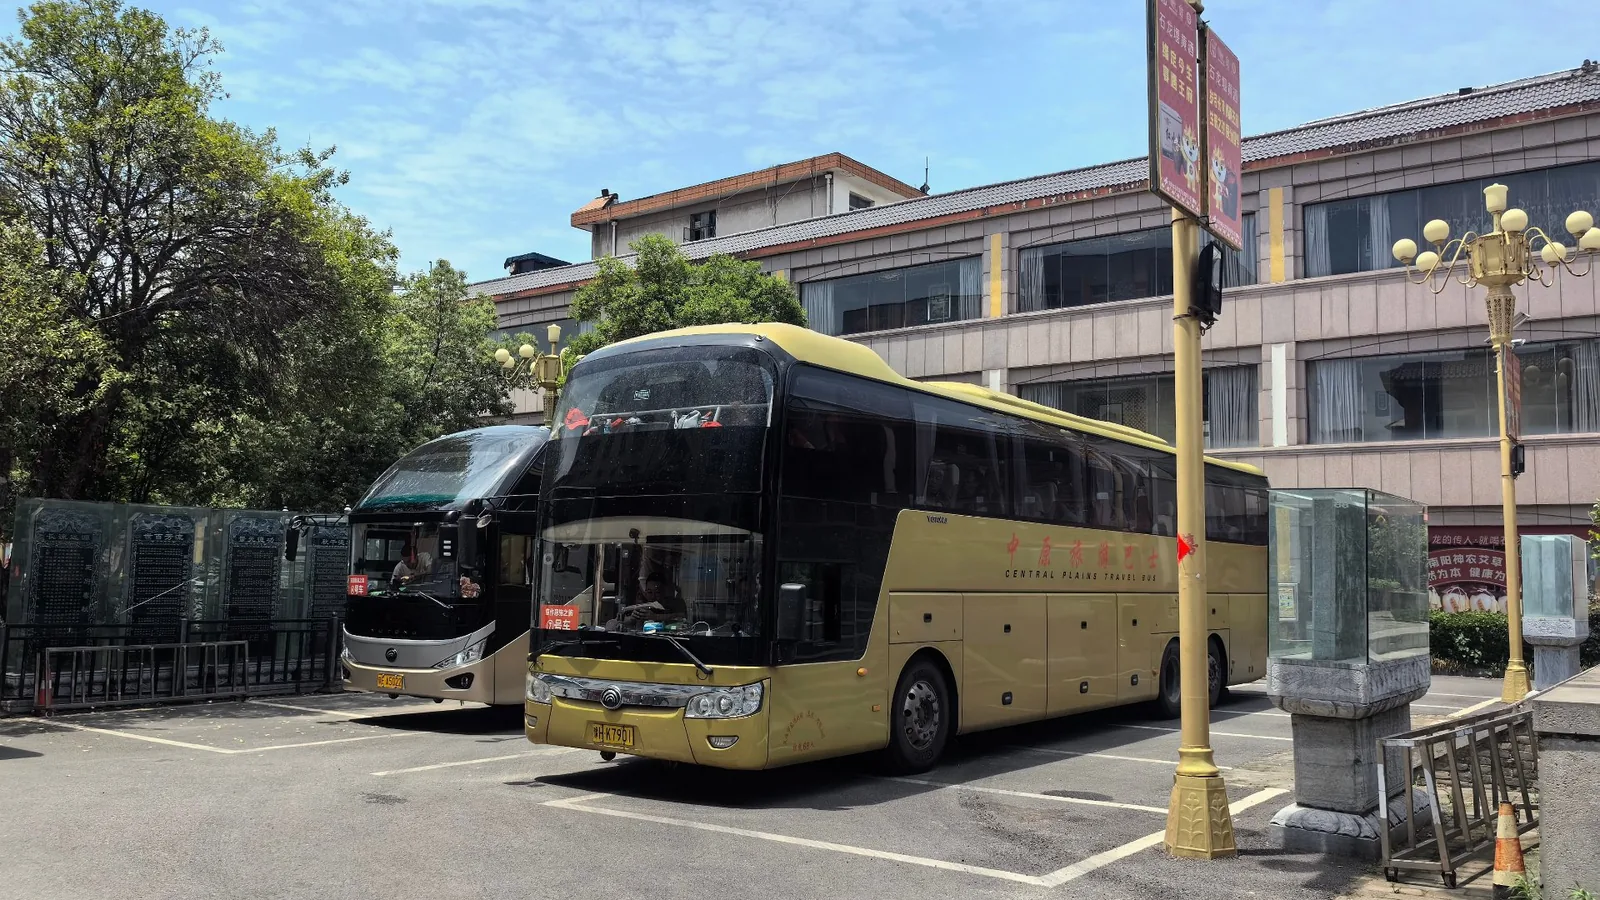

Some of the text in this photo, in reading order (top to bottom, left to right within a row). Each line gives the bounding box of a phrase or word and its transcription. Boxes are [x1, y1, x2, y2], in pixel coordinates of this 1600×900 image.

[1005, 569, 1054, 579] CENTRAL
[1062, 571, 1097, 580] PLAINS
[1104, 572, 1136, 581] TRAVEL
